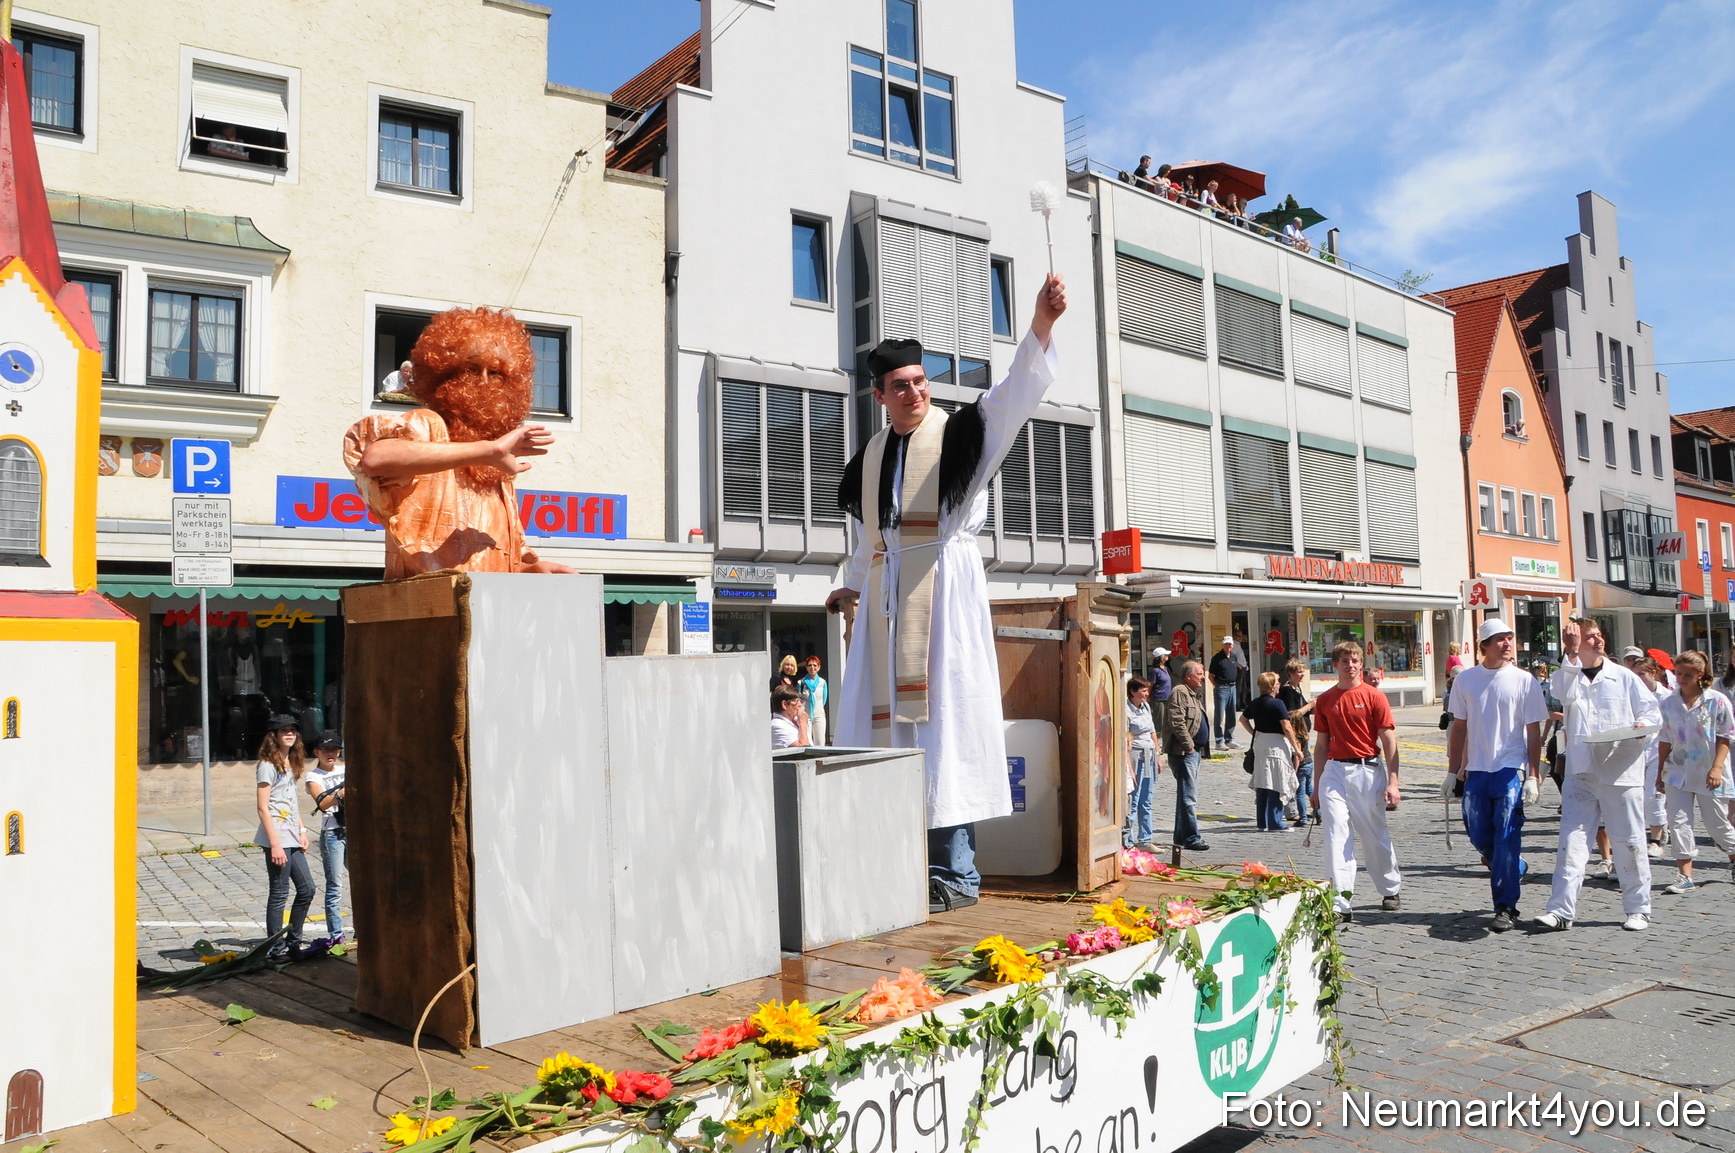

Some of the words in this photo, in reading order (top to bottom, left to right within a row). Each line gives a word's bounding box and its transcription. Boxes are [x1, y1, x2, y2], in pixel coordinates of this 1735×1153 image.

[186, 445, 218, 487] P
[204, 501, 219, 510] mit
[177, 510, 227, 519] Parkschein
[181, 519, 223, 529] werktags
[176, 530, 201, 538] Mo-Fr
[176, 540, 187, 548] Sa
[1656, 537, 1682, 556] H&M
[1103, 544, 1132, 559] ESPRIT
[716, 566, 775, 580] NATHUS
[1267, 554, 1404, 585] MARIEN-APOTHEKE
[253, 602, 326, 629] Life
[1210, 1037, 1248, 1081] KLJB
